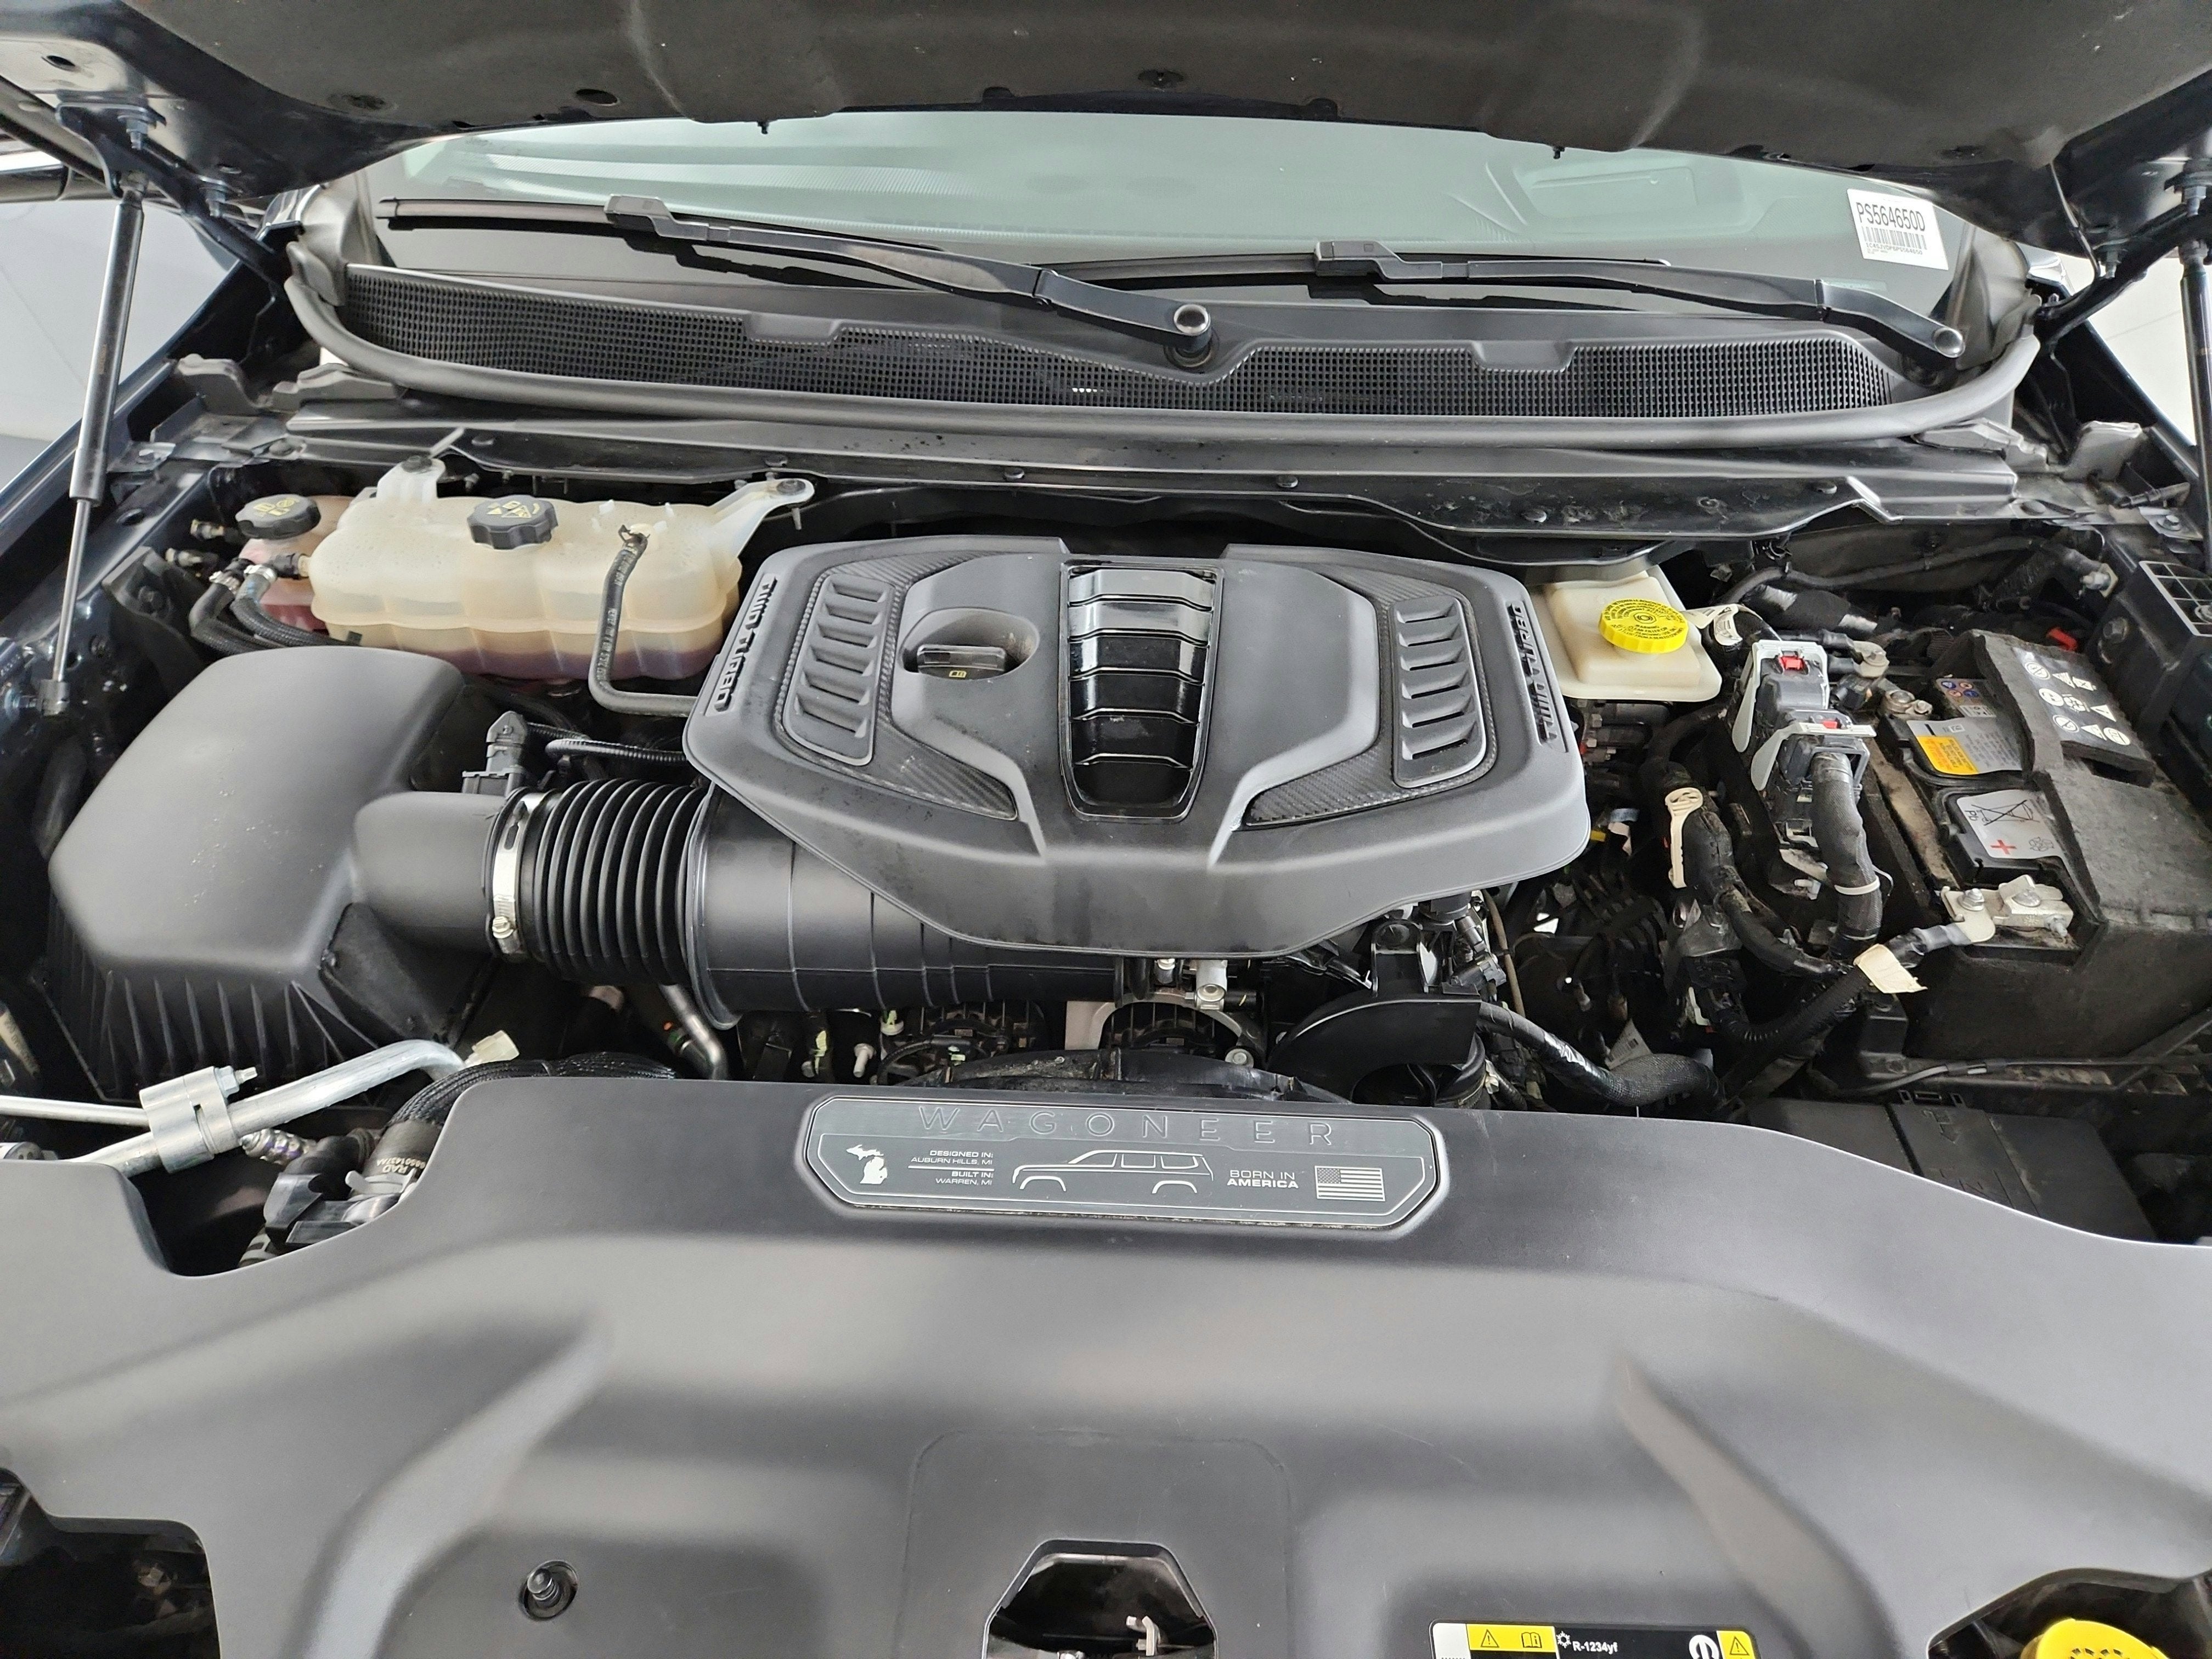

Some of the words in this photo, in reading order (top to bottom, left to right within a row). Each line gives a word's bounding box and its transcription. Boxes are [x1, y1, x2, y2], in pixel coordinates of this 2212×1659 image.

[1856, 202, 1925, 231] PS564650D
[1964, 809, 1977, 821] Pb
[919, 1106, 1334, 1145] WAGONEER
[382, 1164, 409, 1174] RAD
[1229, 1169, 1274, 1179] BORN
[1280, 1171, 1295, 1180] IN
[1227, 1178, 1299, 1188] AMERICA
[1572, 1641, 1618, 1655] R-1234yf
